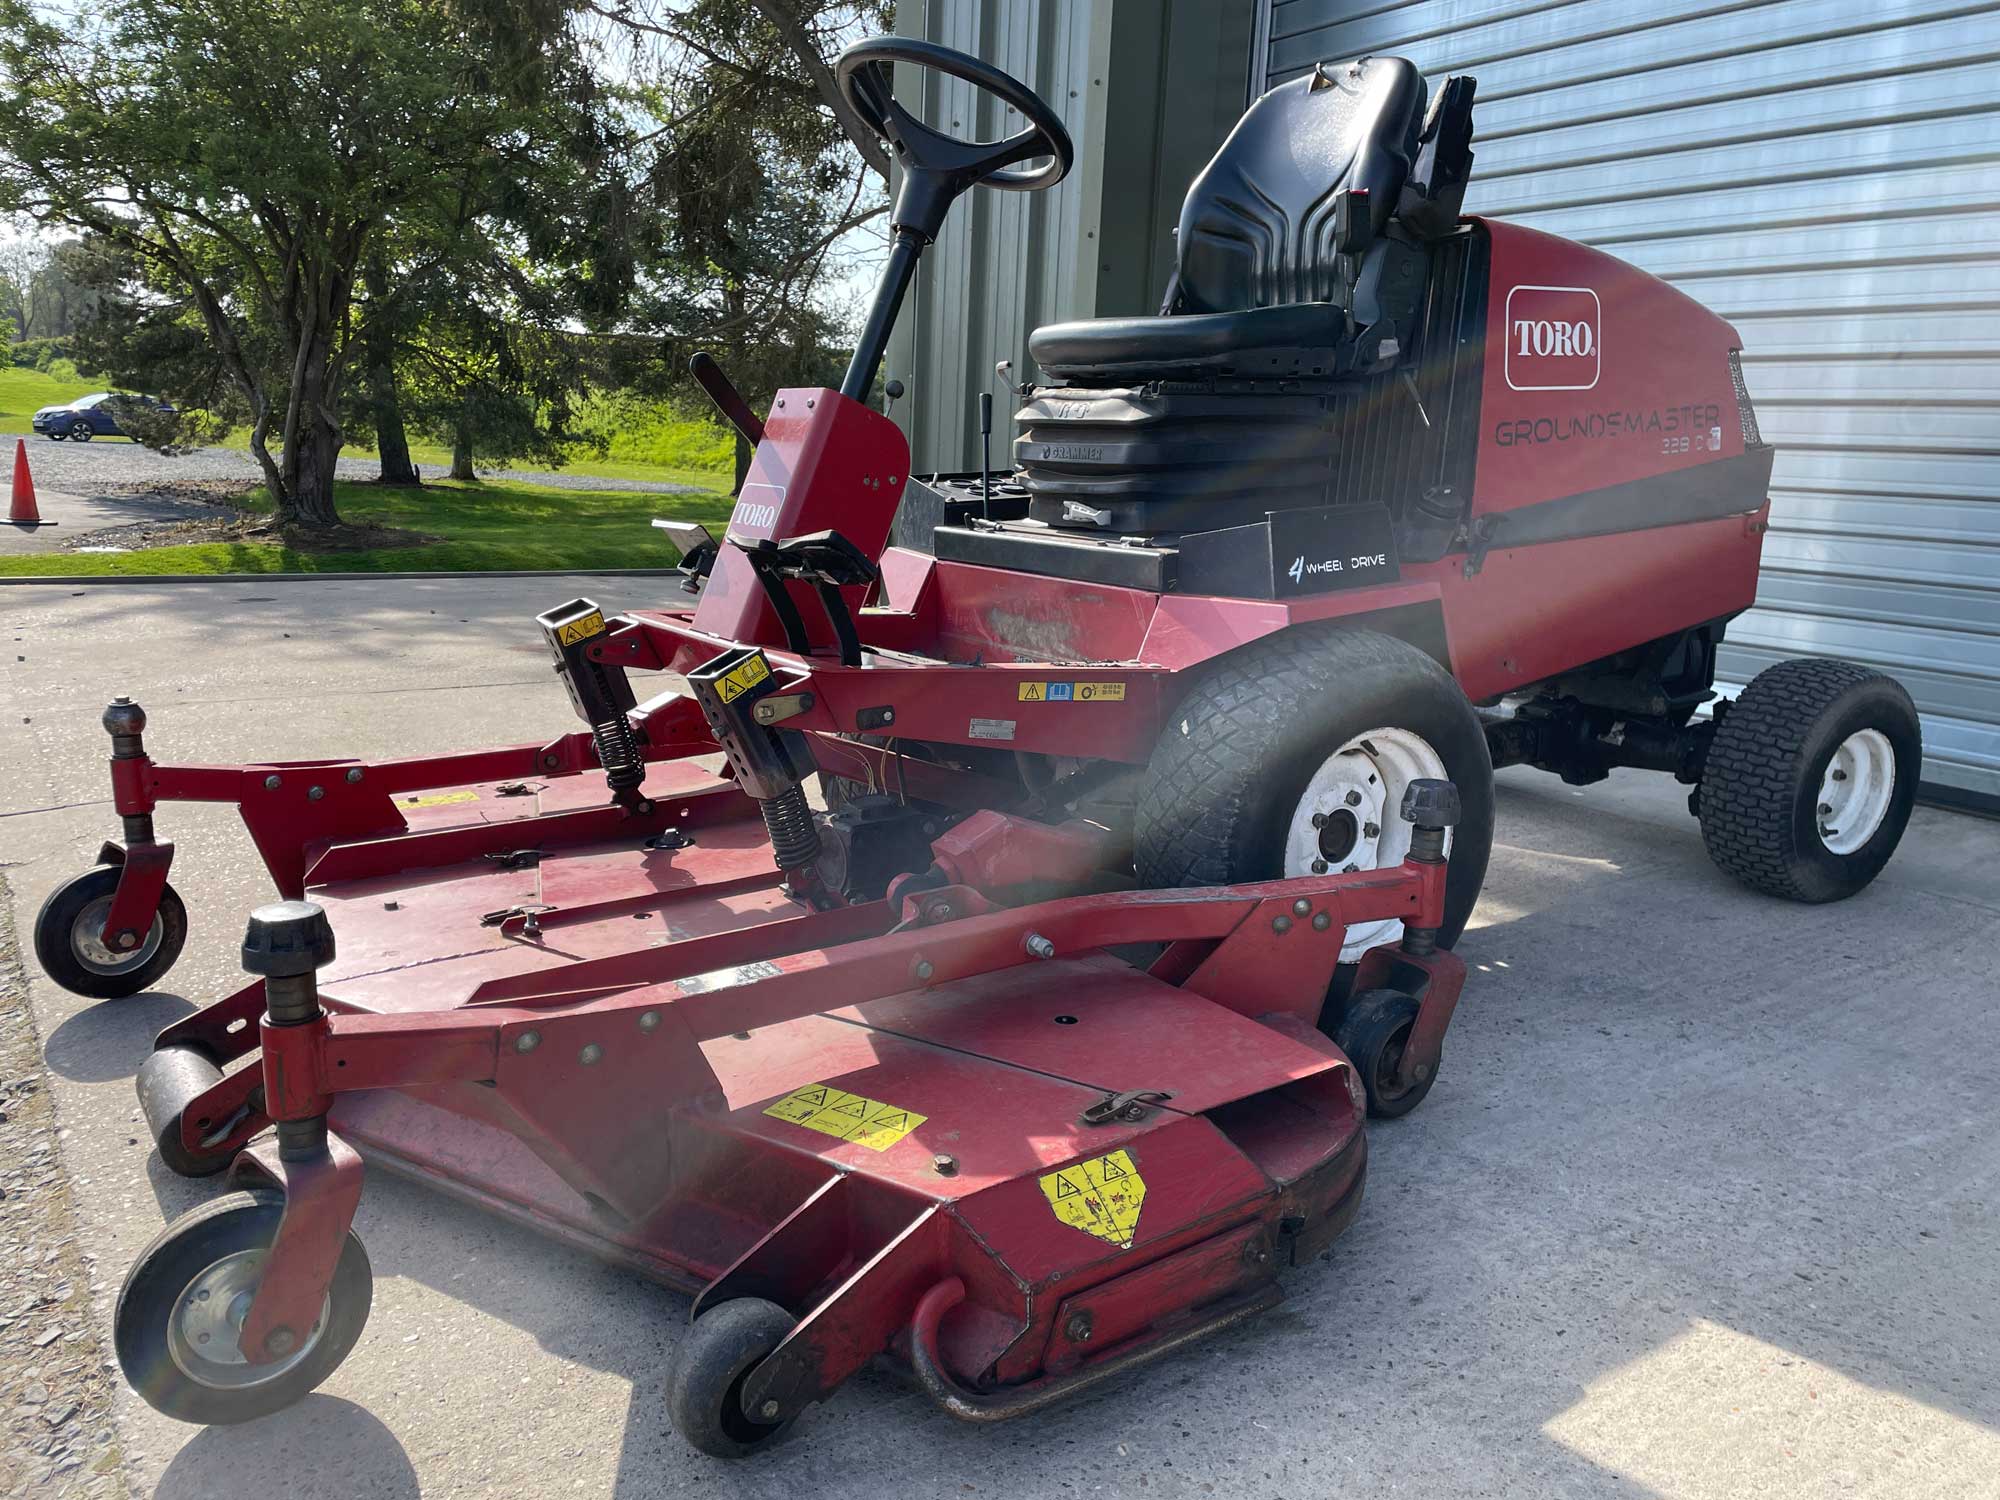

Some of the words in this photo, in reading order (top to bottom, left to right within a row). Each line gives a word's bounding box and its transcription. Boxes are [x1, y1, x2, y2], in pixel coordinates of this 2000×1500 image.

[1514, 320, 1594, 357] TORO
[1495, 404, 1720, 447] GROUNDSMASTER
[1052, 445, 1104, 461] GRAMMER
[735, 502, 775, 528] TORO
[1288, 555, 1304, 584] 4
[1350, 554, 1385, 569] DRIVE
